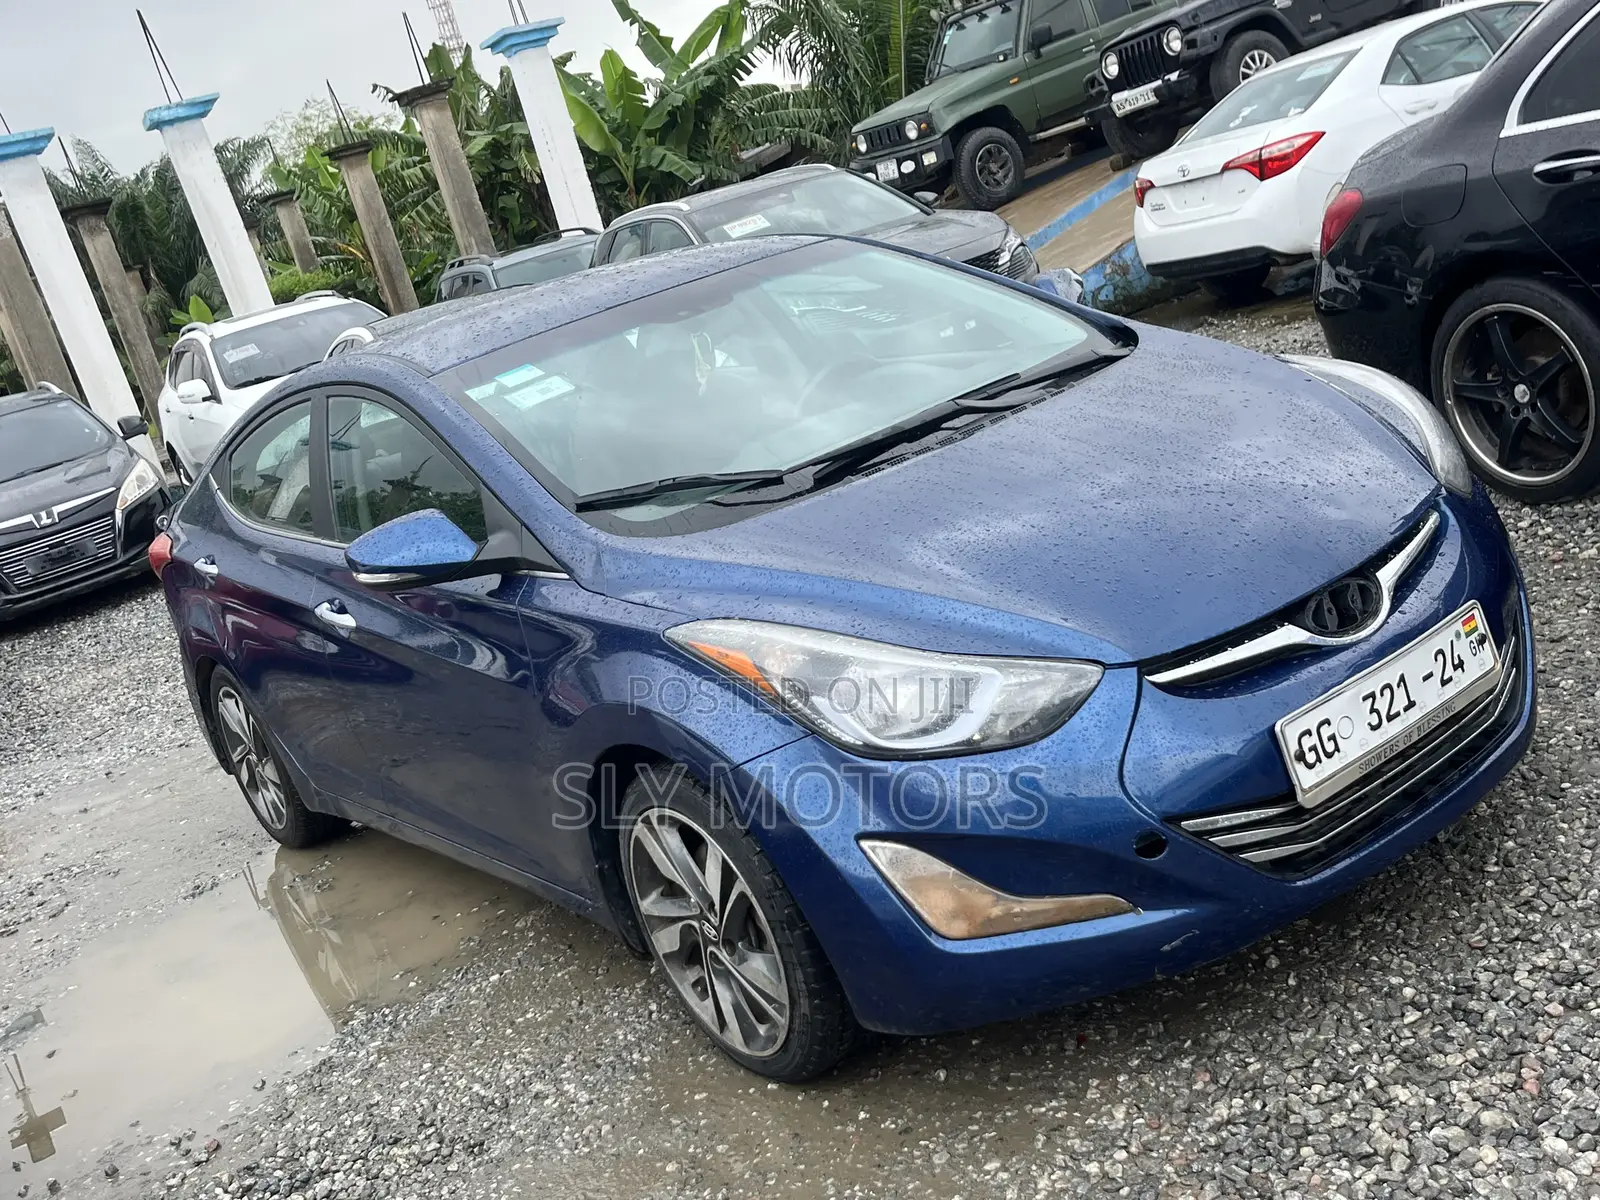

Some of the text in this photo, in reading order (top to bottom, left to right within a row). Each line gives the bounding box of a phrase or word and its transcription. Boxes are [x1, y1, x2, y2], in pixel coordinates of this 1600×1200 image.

[1297, 717, 1341, 770] GG
[1358, 701, 1457, 774] SHOWERS OF BLESSING
